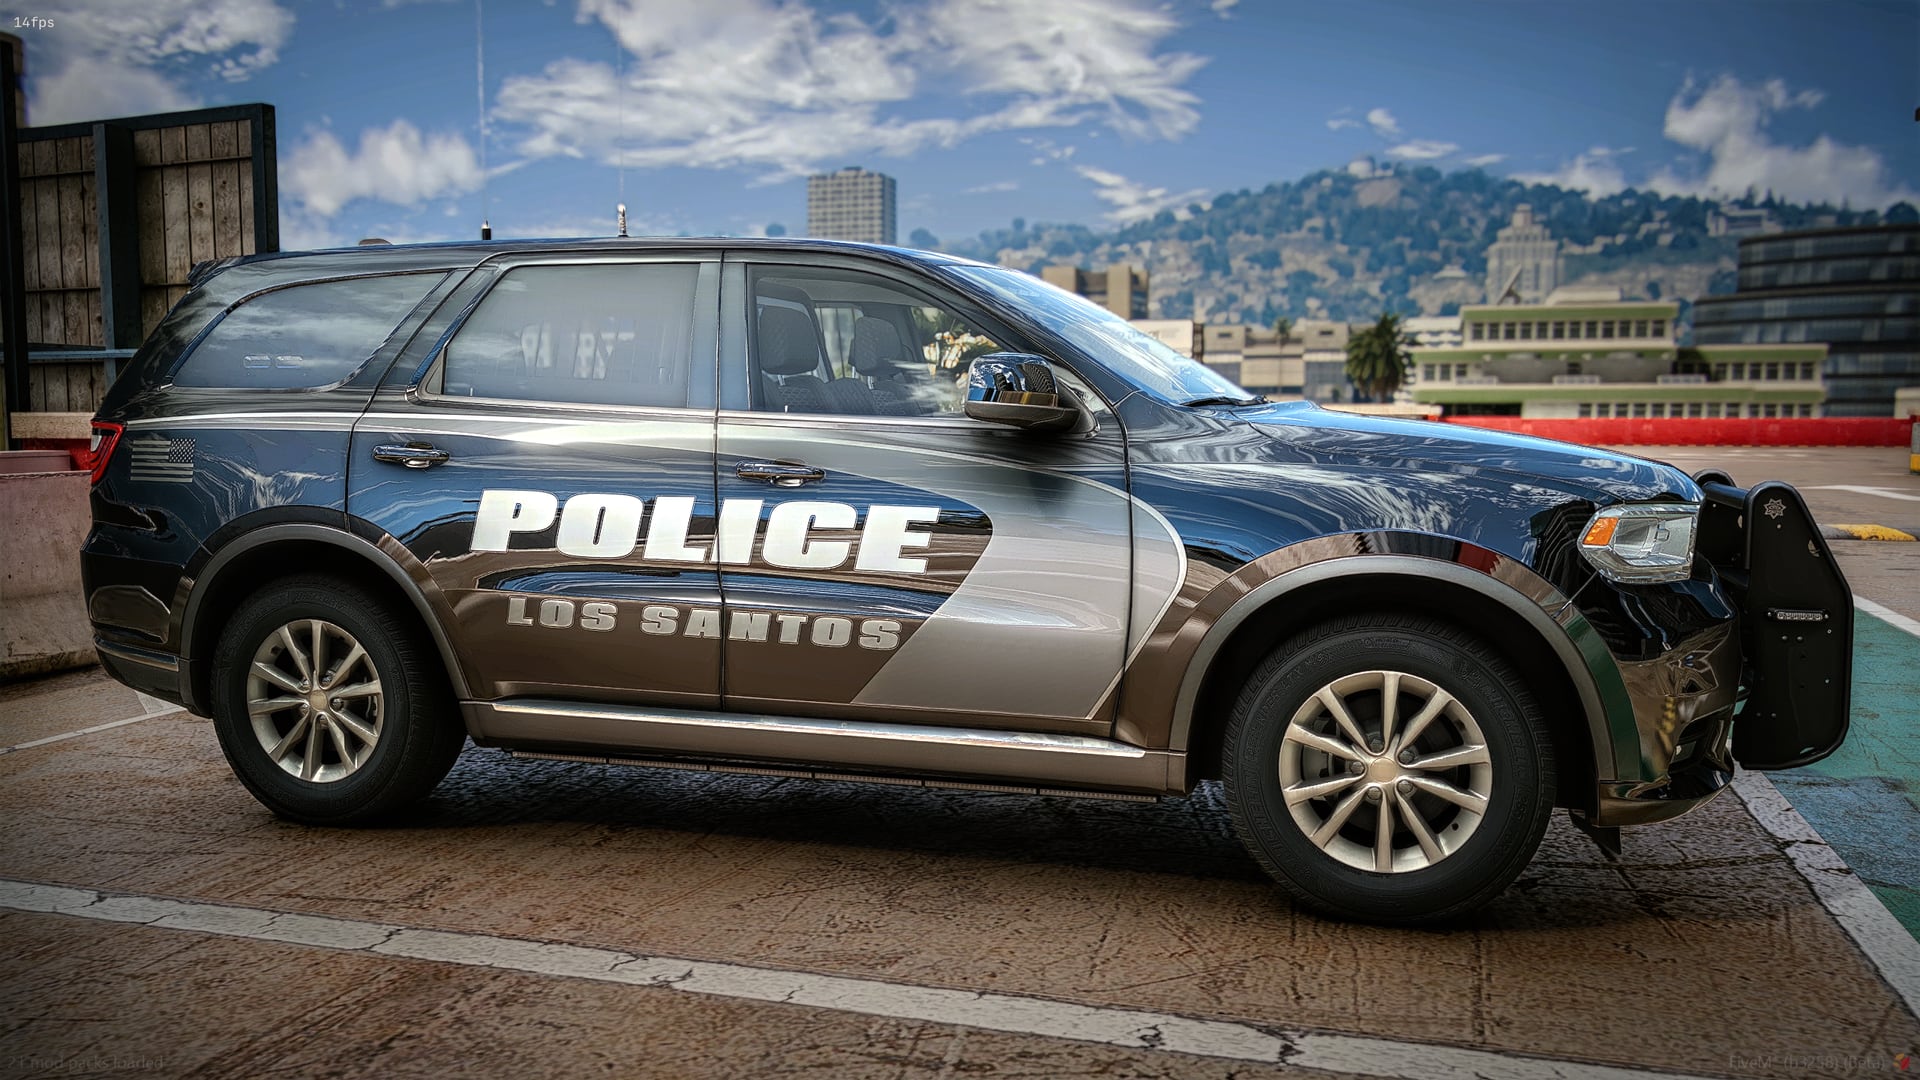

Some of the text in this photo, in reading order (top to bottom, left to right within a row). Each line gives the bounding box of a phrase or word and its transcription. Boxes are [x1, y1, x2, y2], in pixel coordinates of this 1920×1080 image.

[469, 489, 941, 575] POLICE
[506, 595, 902, 651] LOS SANTOS
